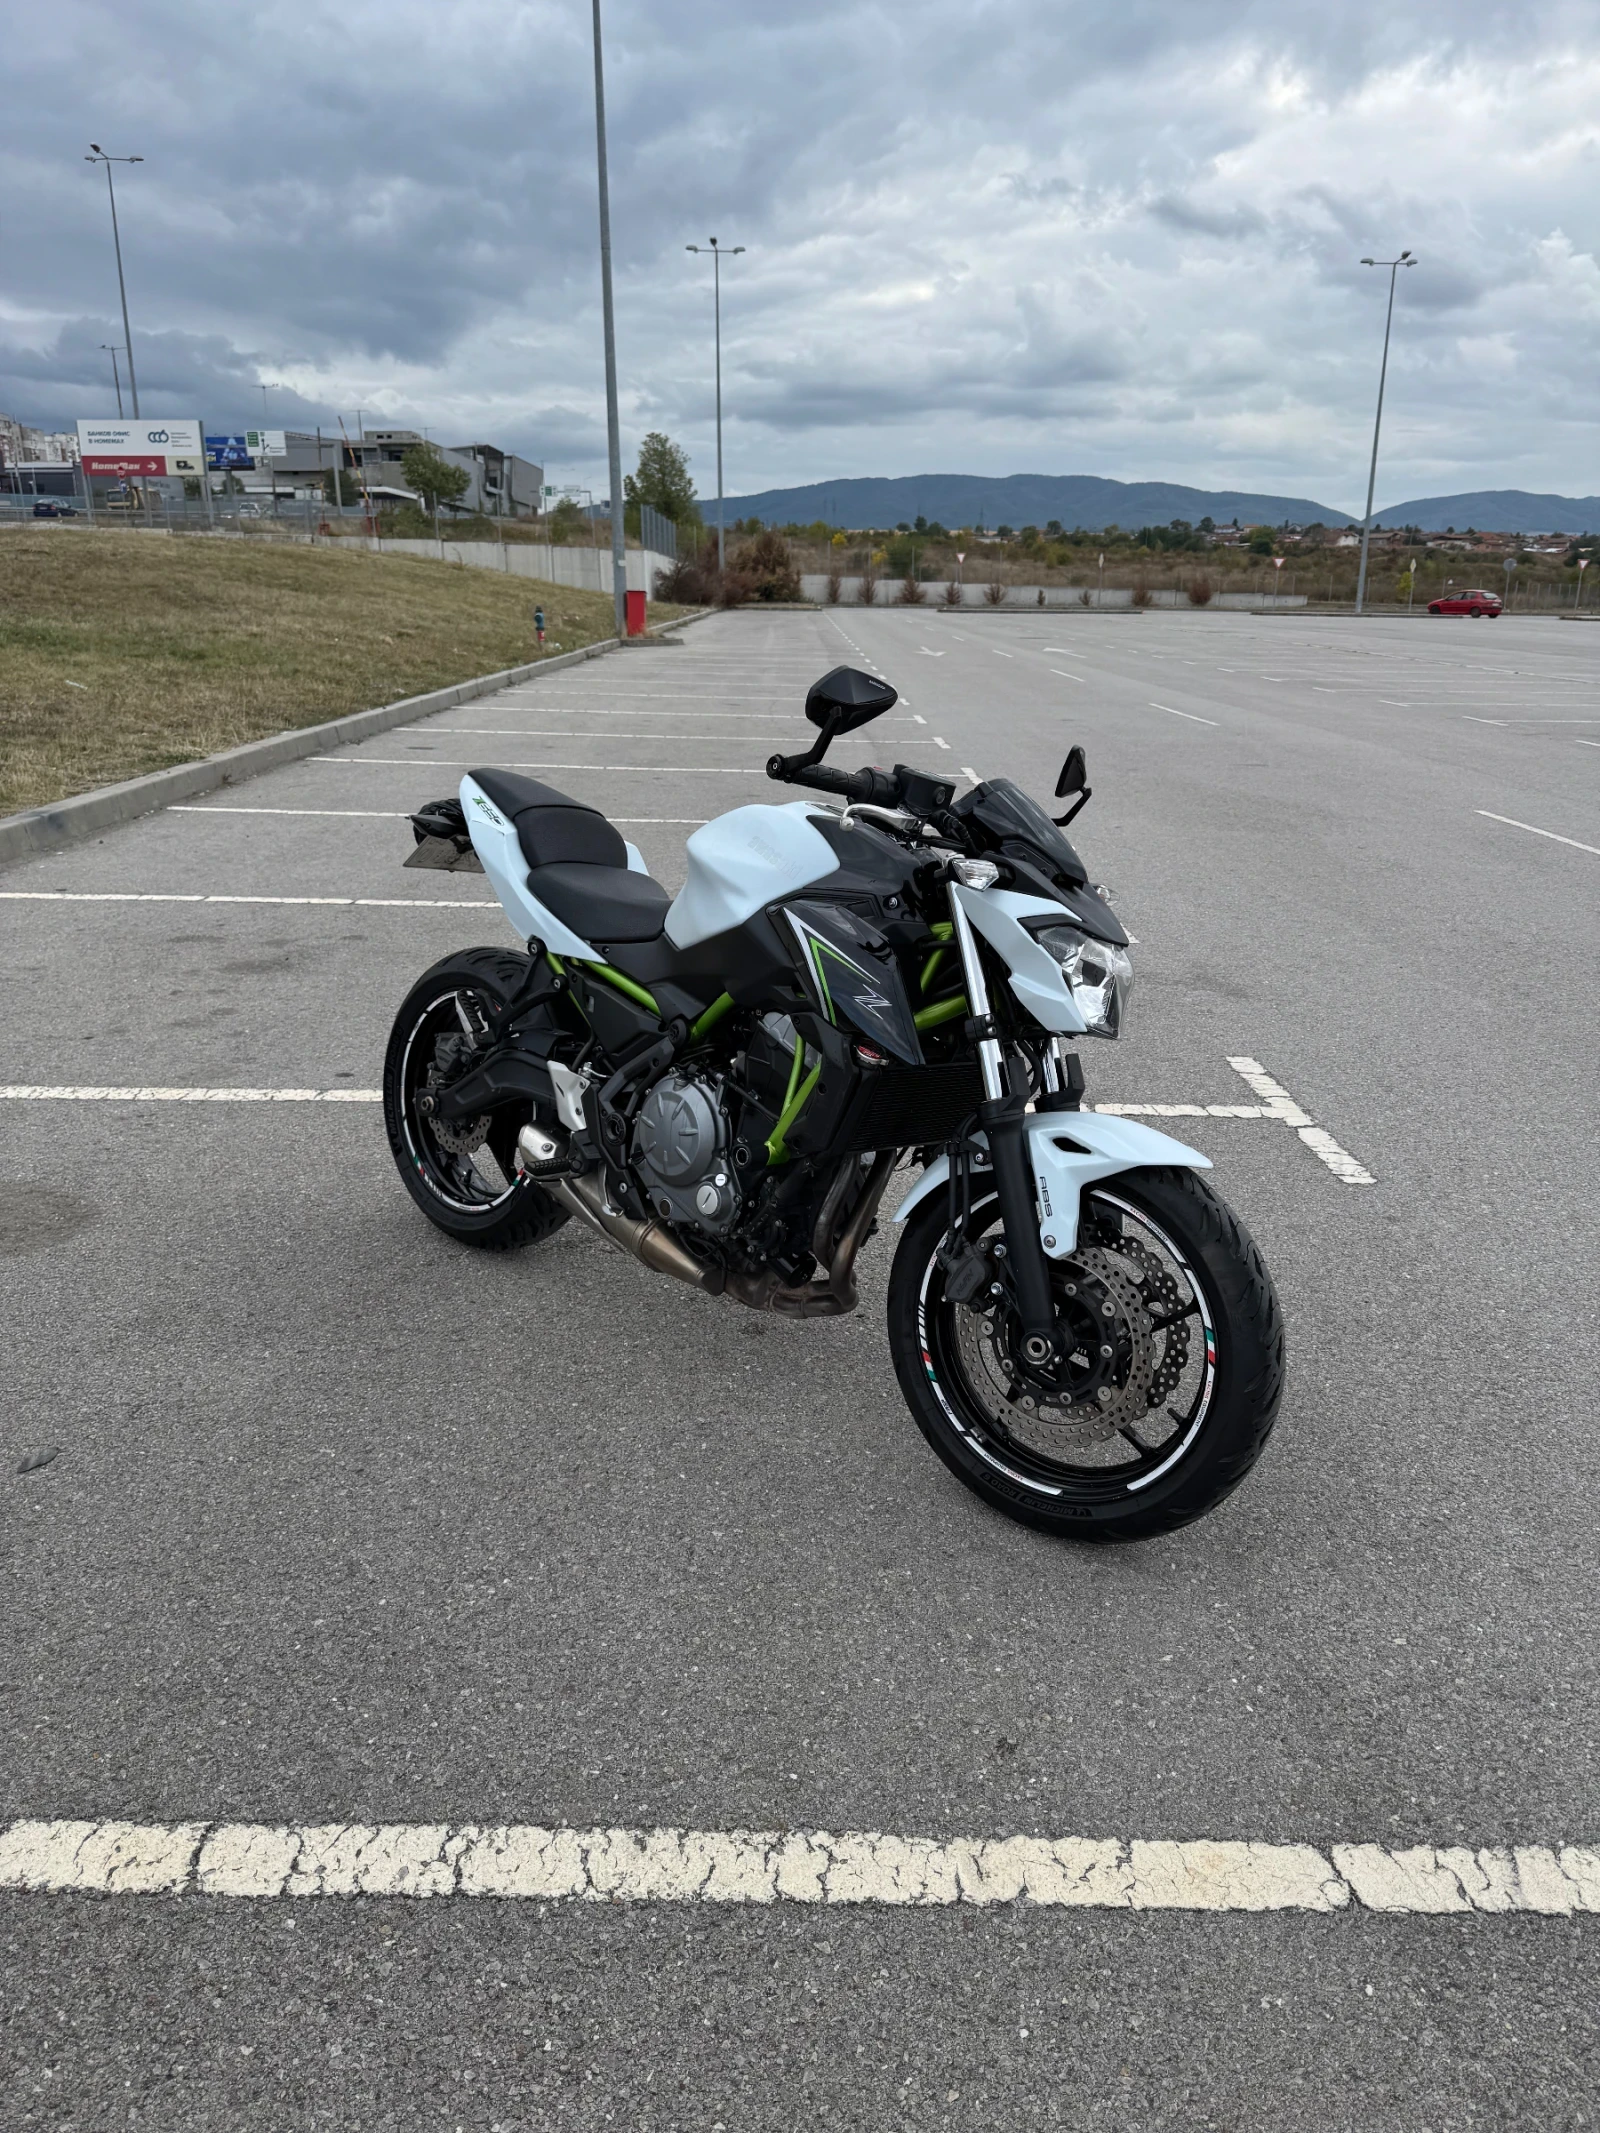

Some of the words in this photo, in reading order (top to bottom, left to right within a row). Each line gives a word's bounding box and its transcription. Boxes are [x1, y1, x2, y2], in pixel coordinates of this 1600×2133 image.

[1039, 1175, 1053, 1218] ABS
[996, 1480, 1017, 1497] ROAD
[1023, 1496, 1075, 1516] MICHELIN
